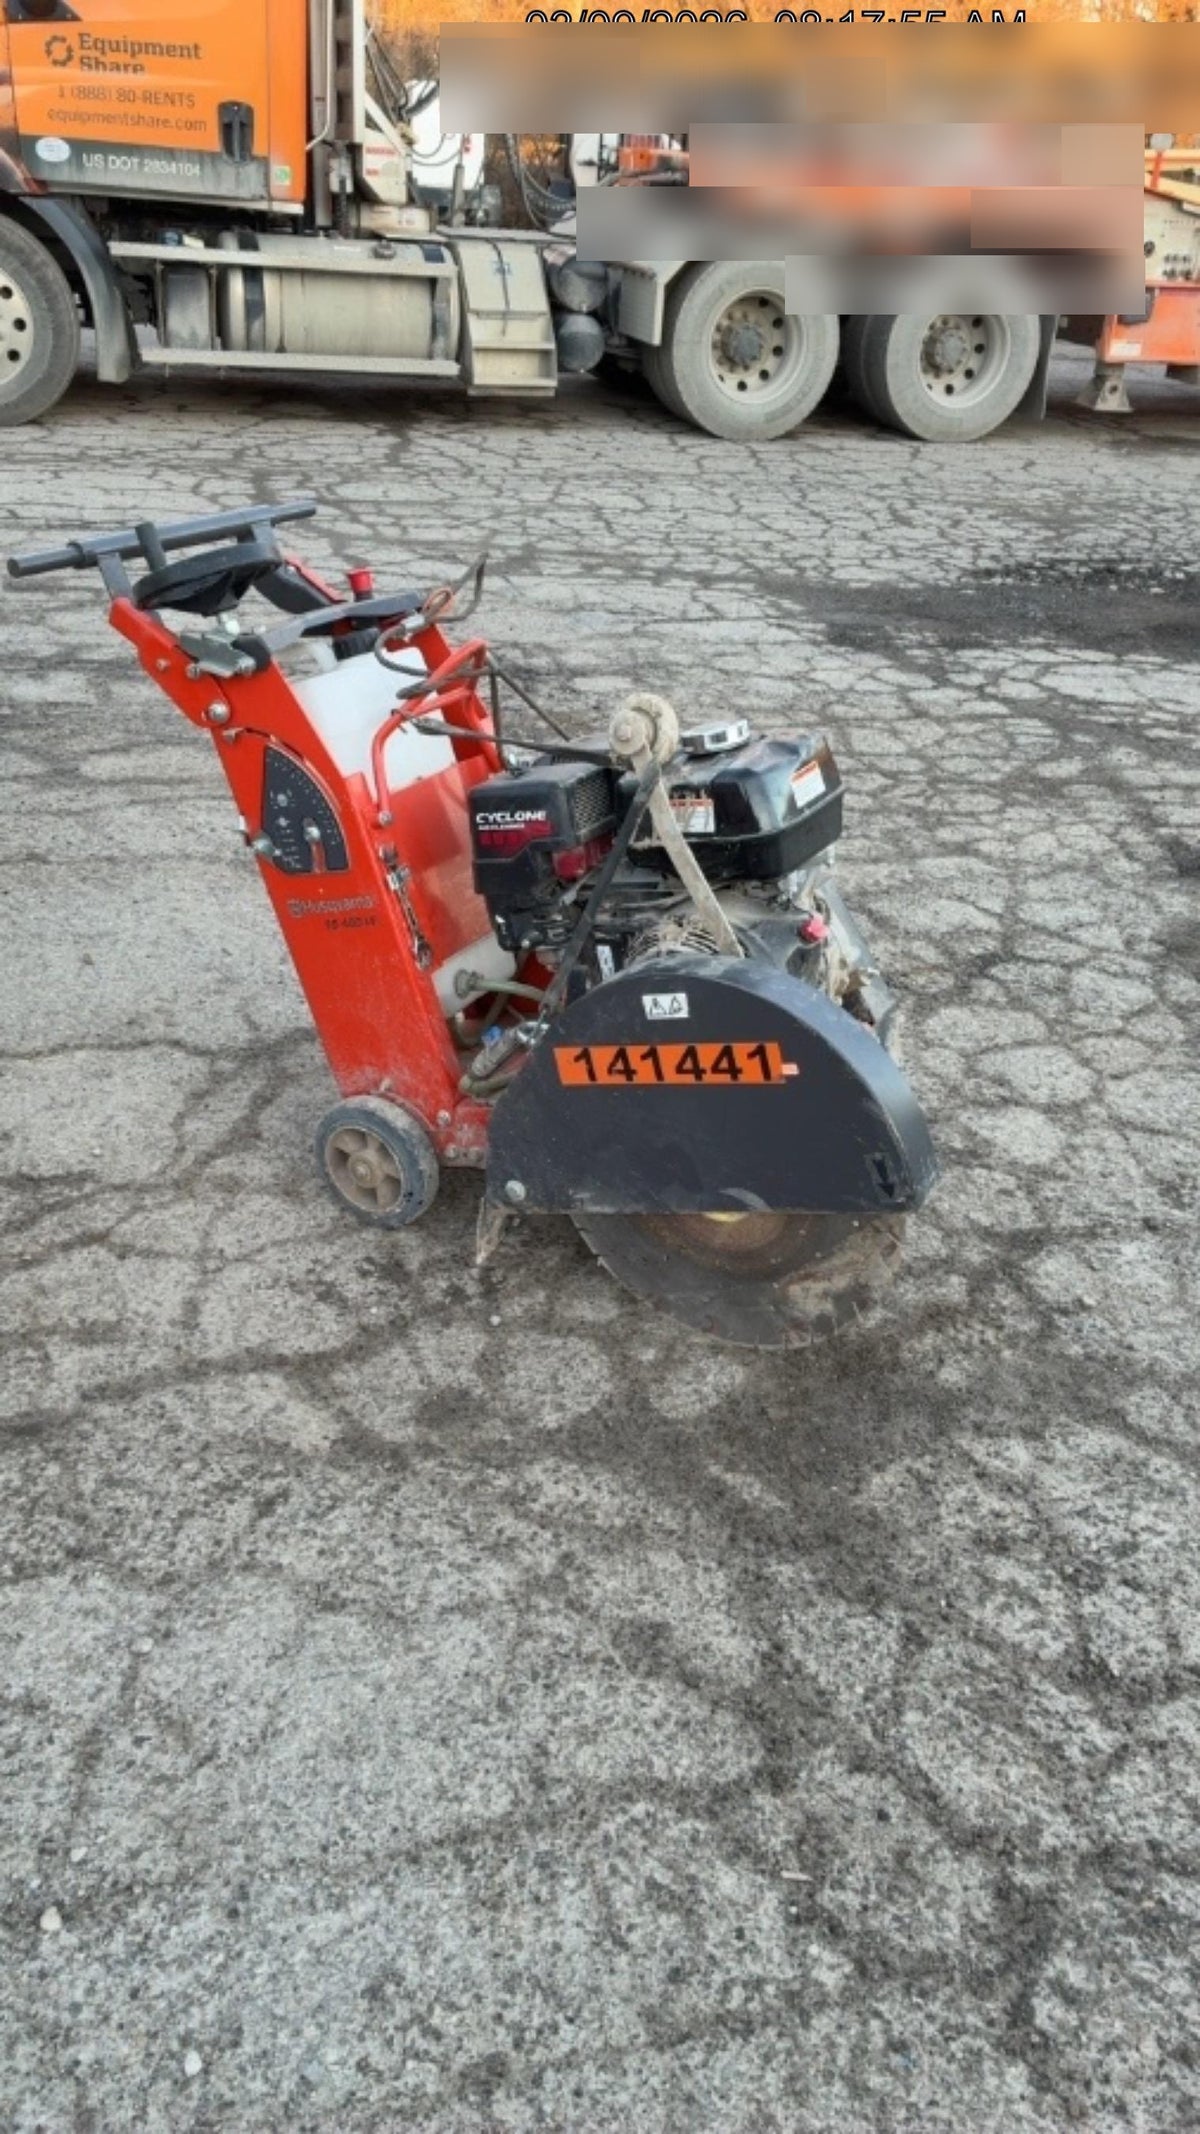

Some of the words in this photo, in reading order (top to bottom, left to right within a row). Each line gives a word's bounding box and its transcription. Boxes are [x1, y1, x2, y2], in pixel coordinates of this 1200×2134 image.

[78, 32, 203, 60] Equipment
[47, 108, 208, 132] equipmentshare.com
[82, 153, 105, 169] US
[107, 156, 141, 172] DOT
[476, 810, 547, 824] CYCLONE
[573, 1044, 772, 1082] 141441
